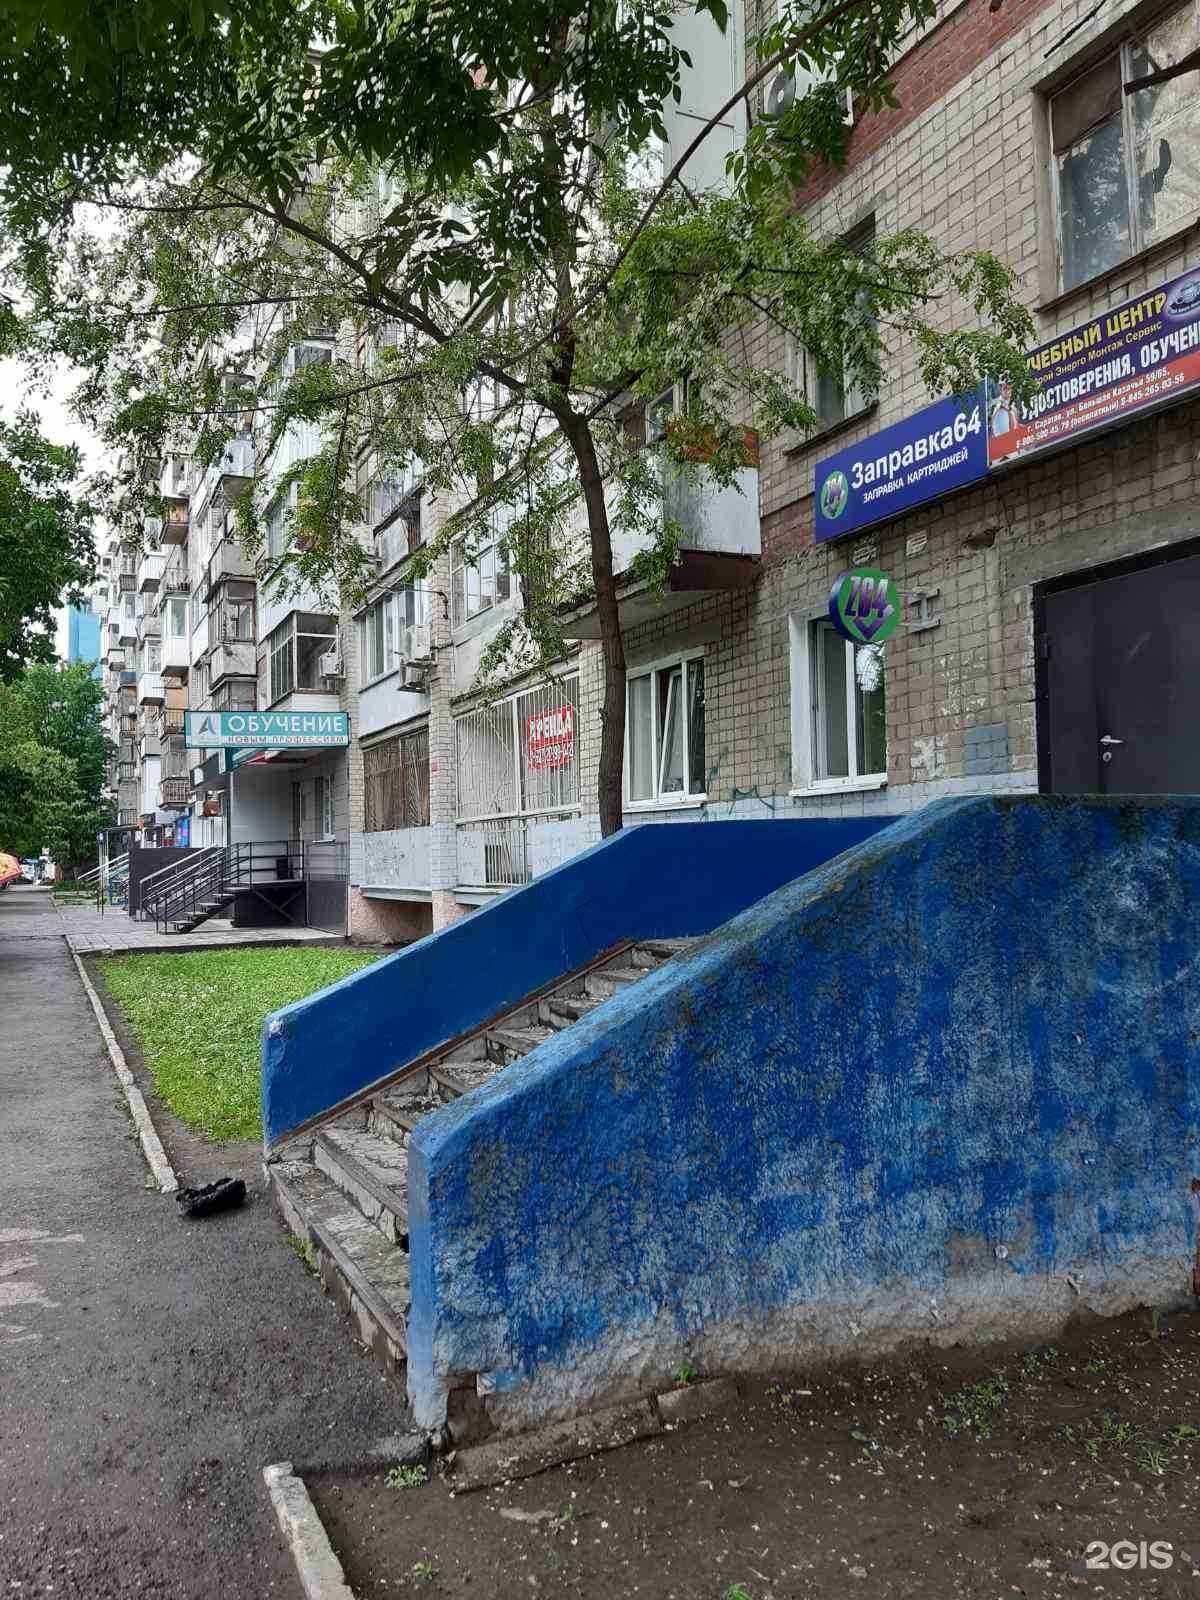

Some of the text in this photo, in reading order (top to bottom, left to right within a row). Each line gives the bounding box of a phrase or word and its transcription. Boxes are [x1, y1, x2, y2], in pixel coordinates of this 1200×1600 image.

[1106, 292, 1167, 337] ЦЕНТР
[1088, 339, 1123, 360] Монтаж
[1125, 321, 1163, 343] Сервис
[851, 405, 982, 489] Заправка64
[863, 447, 969, 504] ЗАПРАВКА КАРТРИДЖЕЙ
[228, 715, 343, 733] ОБУЧЕНИЕ
